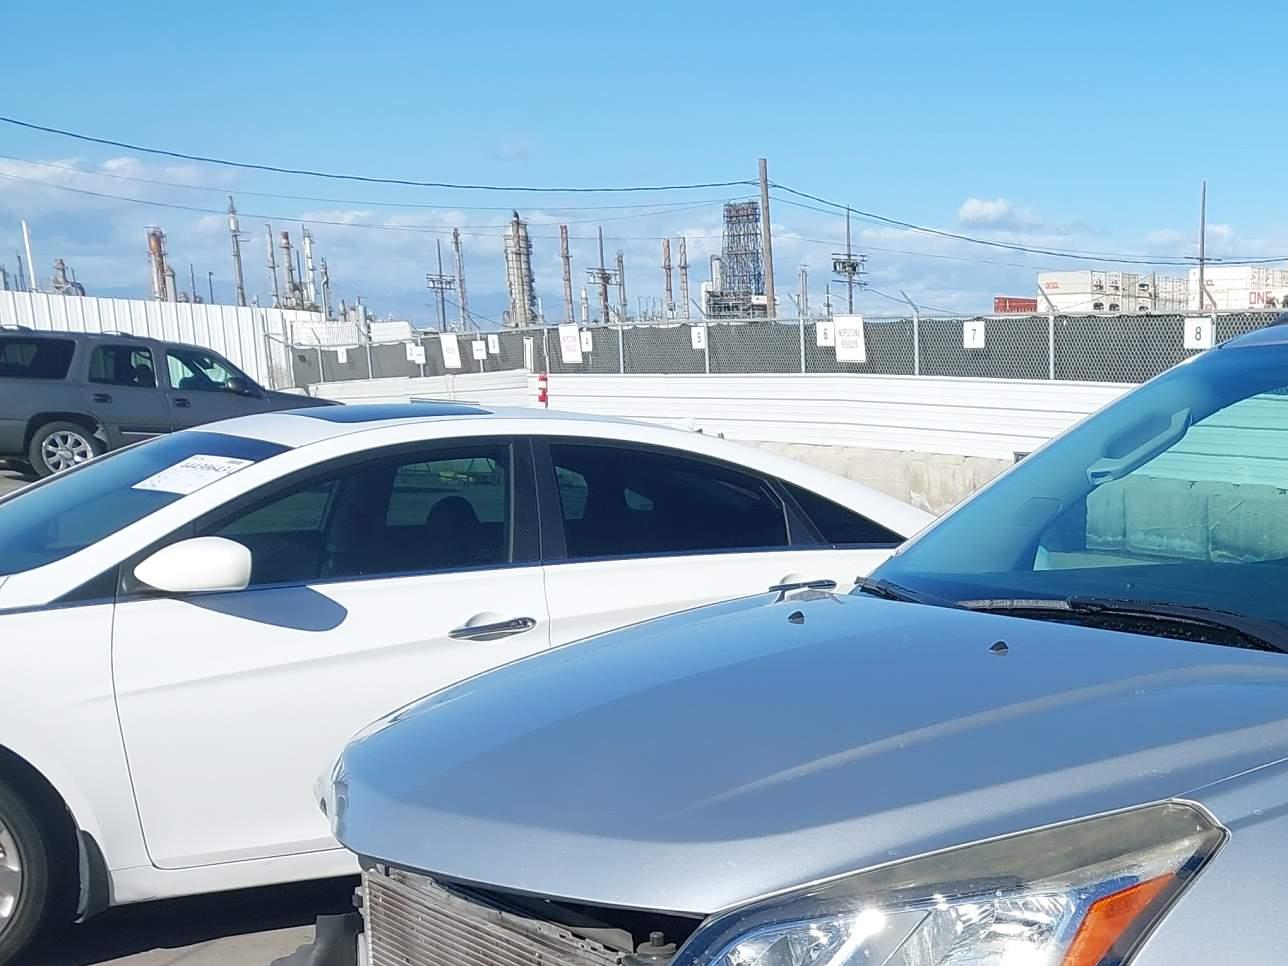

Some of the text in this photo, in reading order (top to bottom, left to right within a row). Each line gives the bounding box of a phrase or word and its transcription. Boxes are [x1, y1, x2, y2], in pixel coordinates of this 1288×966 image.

[823, 328, 829, 341] 6
[971, 328, 977, 341] 7
[1195, 326, 1202, 341] 8
